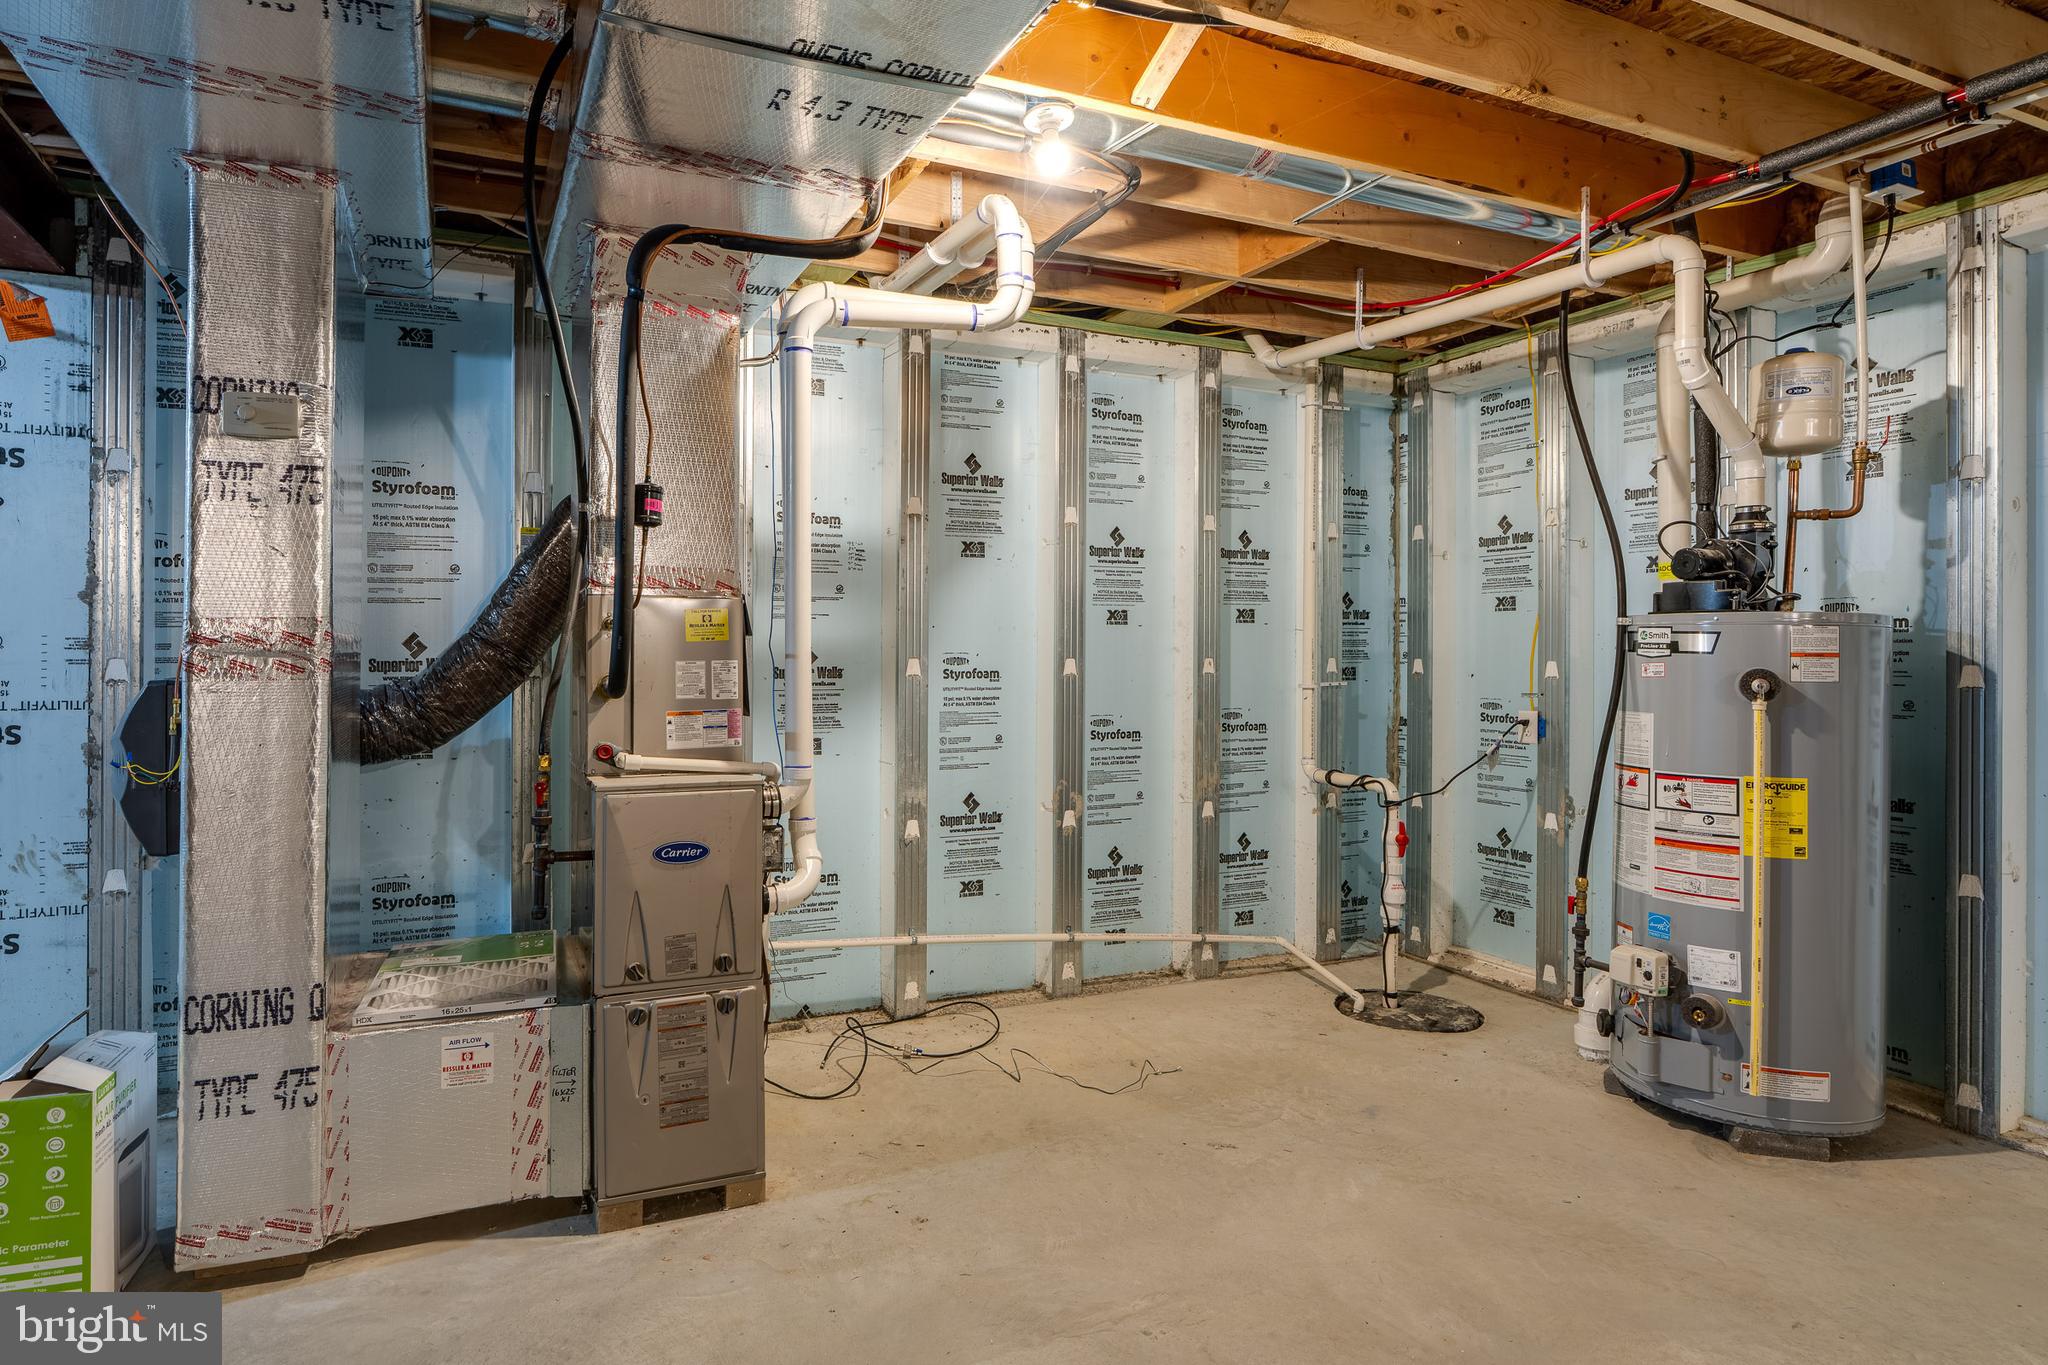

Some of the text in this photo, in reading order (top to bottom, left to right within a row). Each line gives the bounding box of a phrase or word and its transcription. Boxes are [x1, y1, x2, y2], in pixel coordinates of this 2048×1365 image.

[856, 104, 923, 135] TYPE
[1876, 368, 1915, 388] Walls
[1091, 407, 1142, 421] Styrofoam
[1480, 398, 1530, 416] Styrofoam
[1222, 417, 1268, 431] Styrofoam
[376, 466, 406, 478] DUPONT
[201, 460, 323, 505] TYPE 475
[941, 472, 1004, 488] Superior Walls
[372, 479, 456, 497] Styrofoam
[1479, 532, 1534, 548] Superior Walls
[1089, 545, 1145, 559] Superior Walls
[1221, 548, 1270, 561] Superior Walls
[1824, 602, 1855, 613] DUPONT
[1353, 610, 1370, 621] Walls
[1649, 631, 1669, 639] Smith
[368, 657, 423, 675] Superior
[945, 656, 967, 666] DUPONT
[817, 666, 844, 679] Walls
[943, 668, 1000, 681] Styrofoam
[1480, 712, 1519, 725] Styrofo
[1222, 722, 1267, 734] Styrofoam
[1090, 729, 1141, 742] Styrofoam
[1746, 781, 1806, 791] ERGYGUIDE
[1890, 800, 1916, 815] alls
[940, 811, 1003, 828] Superior Walls
[661, 846, 703, 858] Carrier
[1219, 849, 1270, 864] Superior Walls
[1477, 843, 1532, 863] Superior Walls
[1087, 863, 1143, 880] Superior Walls
[376, 881, 406, 893] DUPONT
[372, 893, 456, 911] Styrofoam
[184, 986, 295, 1035] CORNING
[355, 1017, 373, 1025] HDX
[194, 1065, 321, 1122] TYPE 475
[104, 1100, 114, 1118] AIR
[95, 1126, 105, 1137] Fresh
[12, 1240, 70, 1253] Parameter
